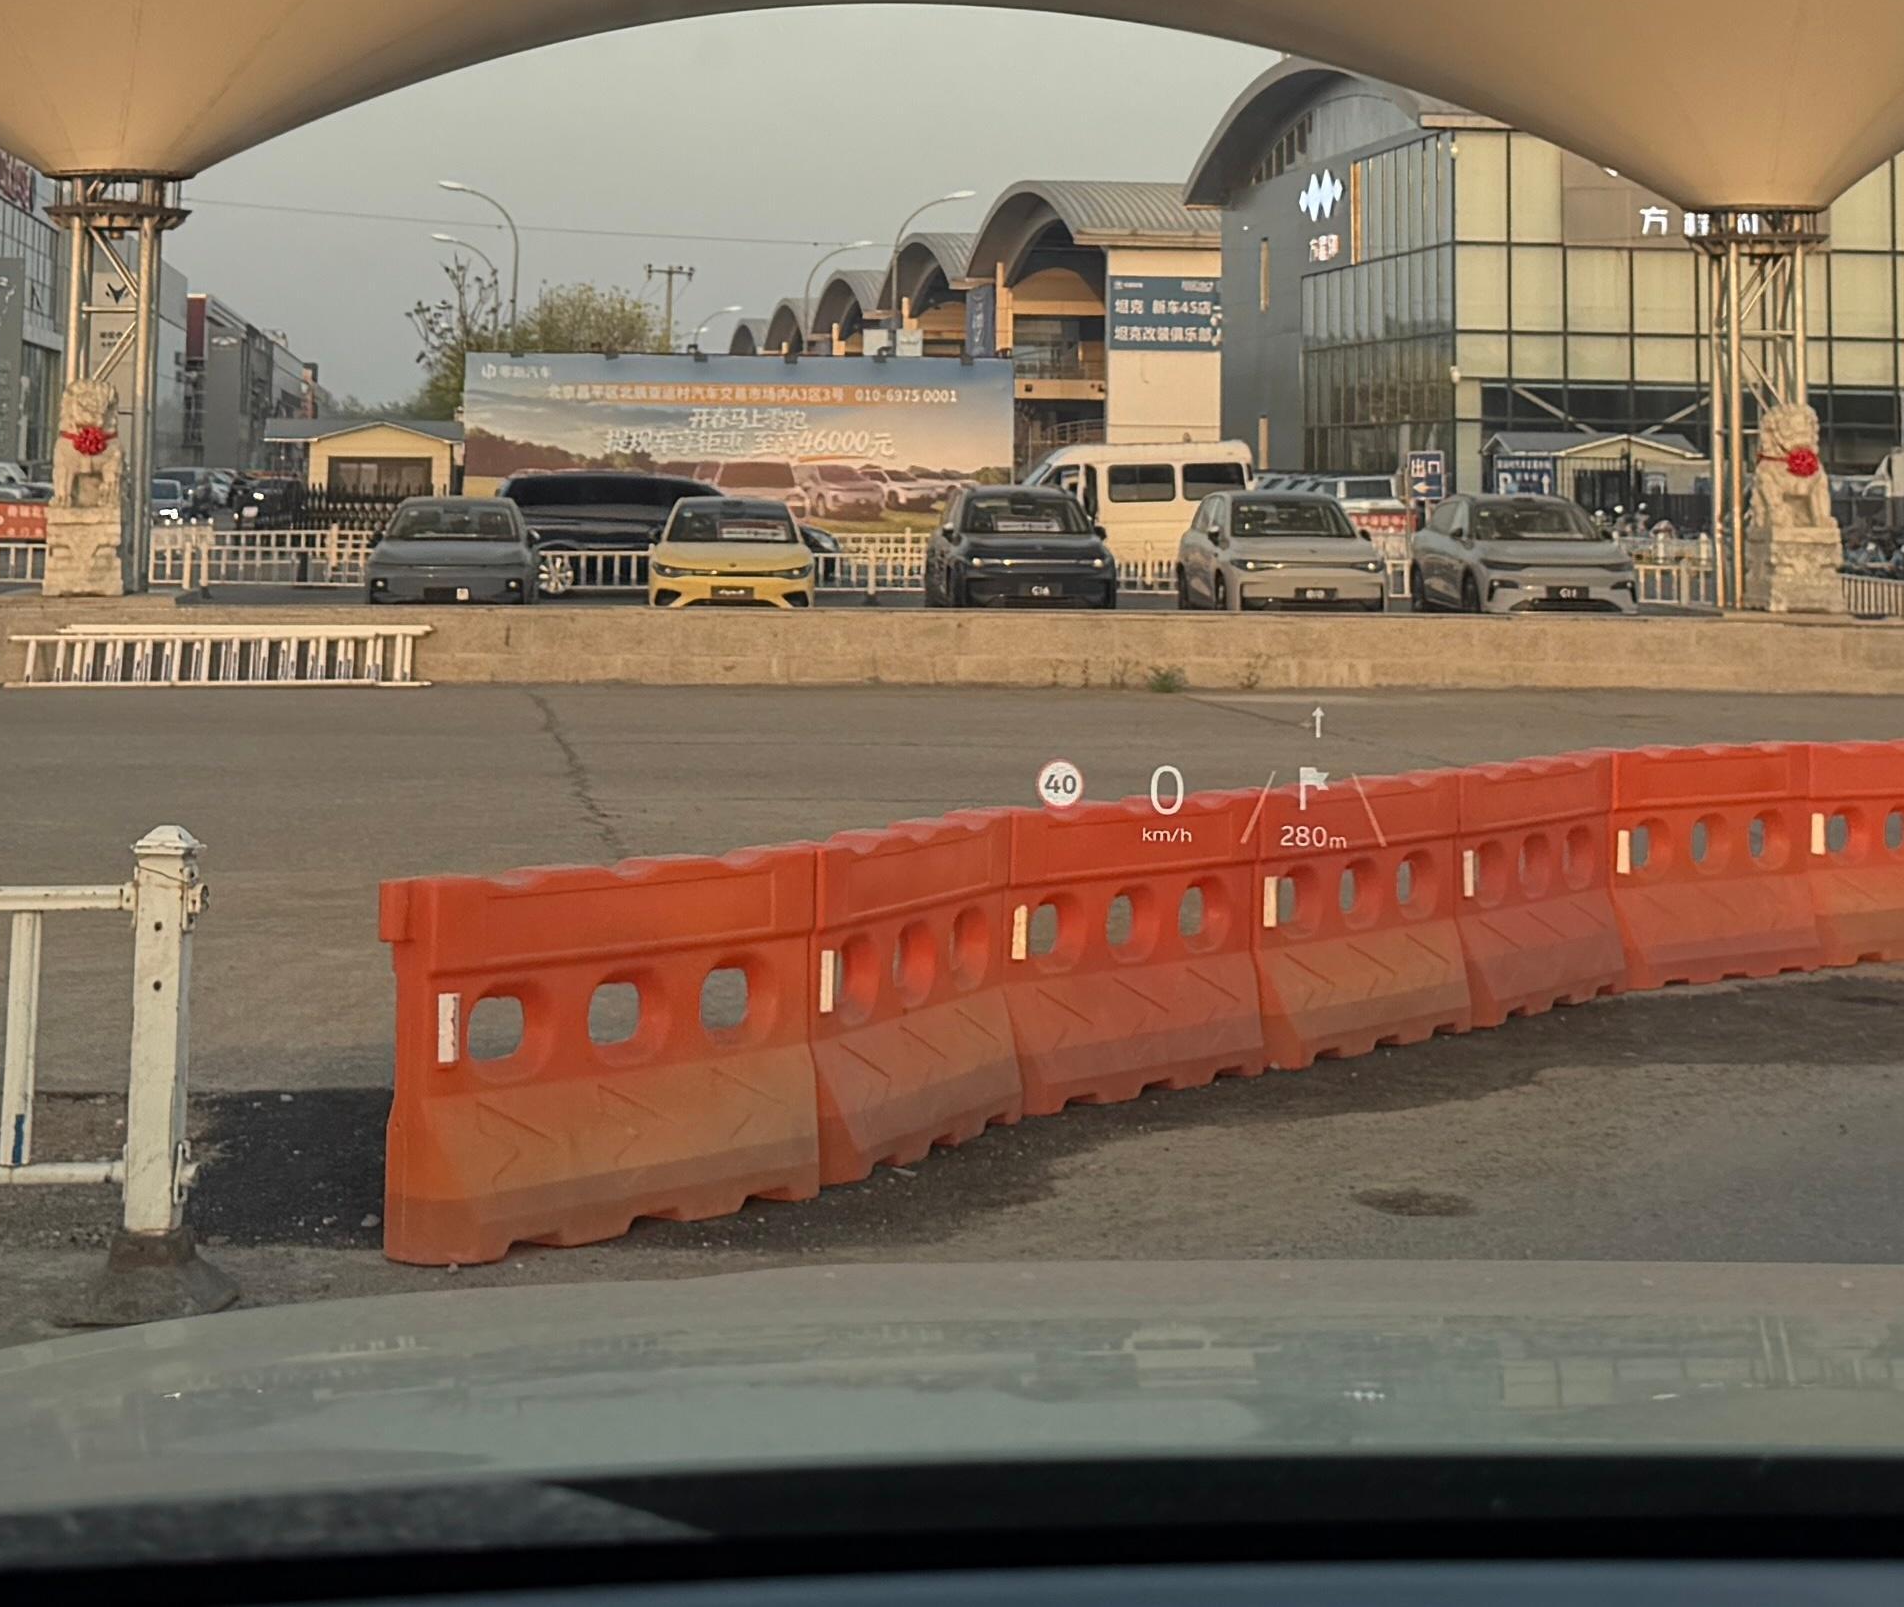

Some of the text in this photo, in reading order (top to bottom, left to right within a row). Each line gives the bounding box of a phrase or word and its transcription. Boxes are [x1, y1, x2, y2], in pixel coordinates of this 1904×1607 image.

[1411, 458, 1442, 478] 出口
[1044, 765, 1185, 816] 40 0
[1141, 827, 1193, 843] km/h
